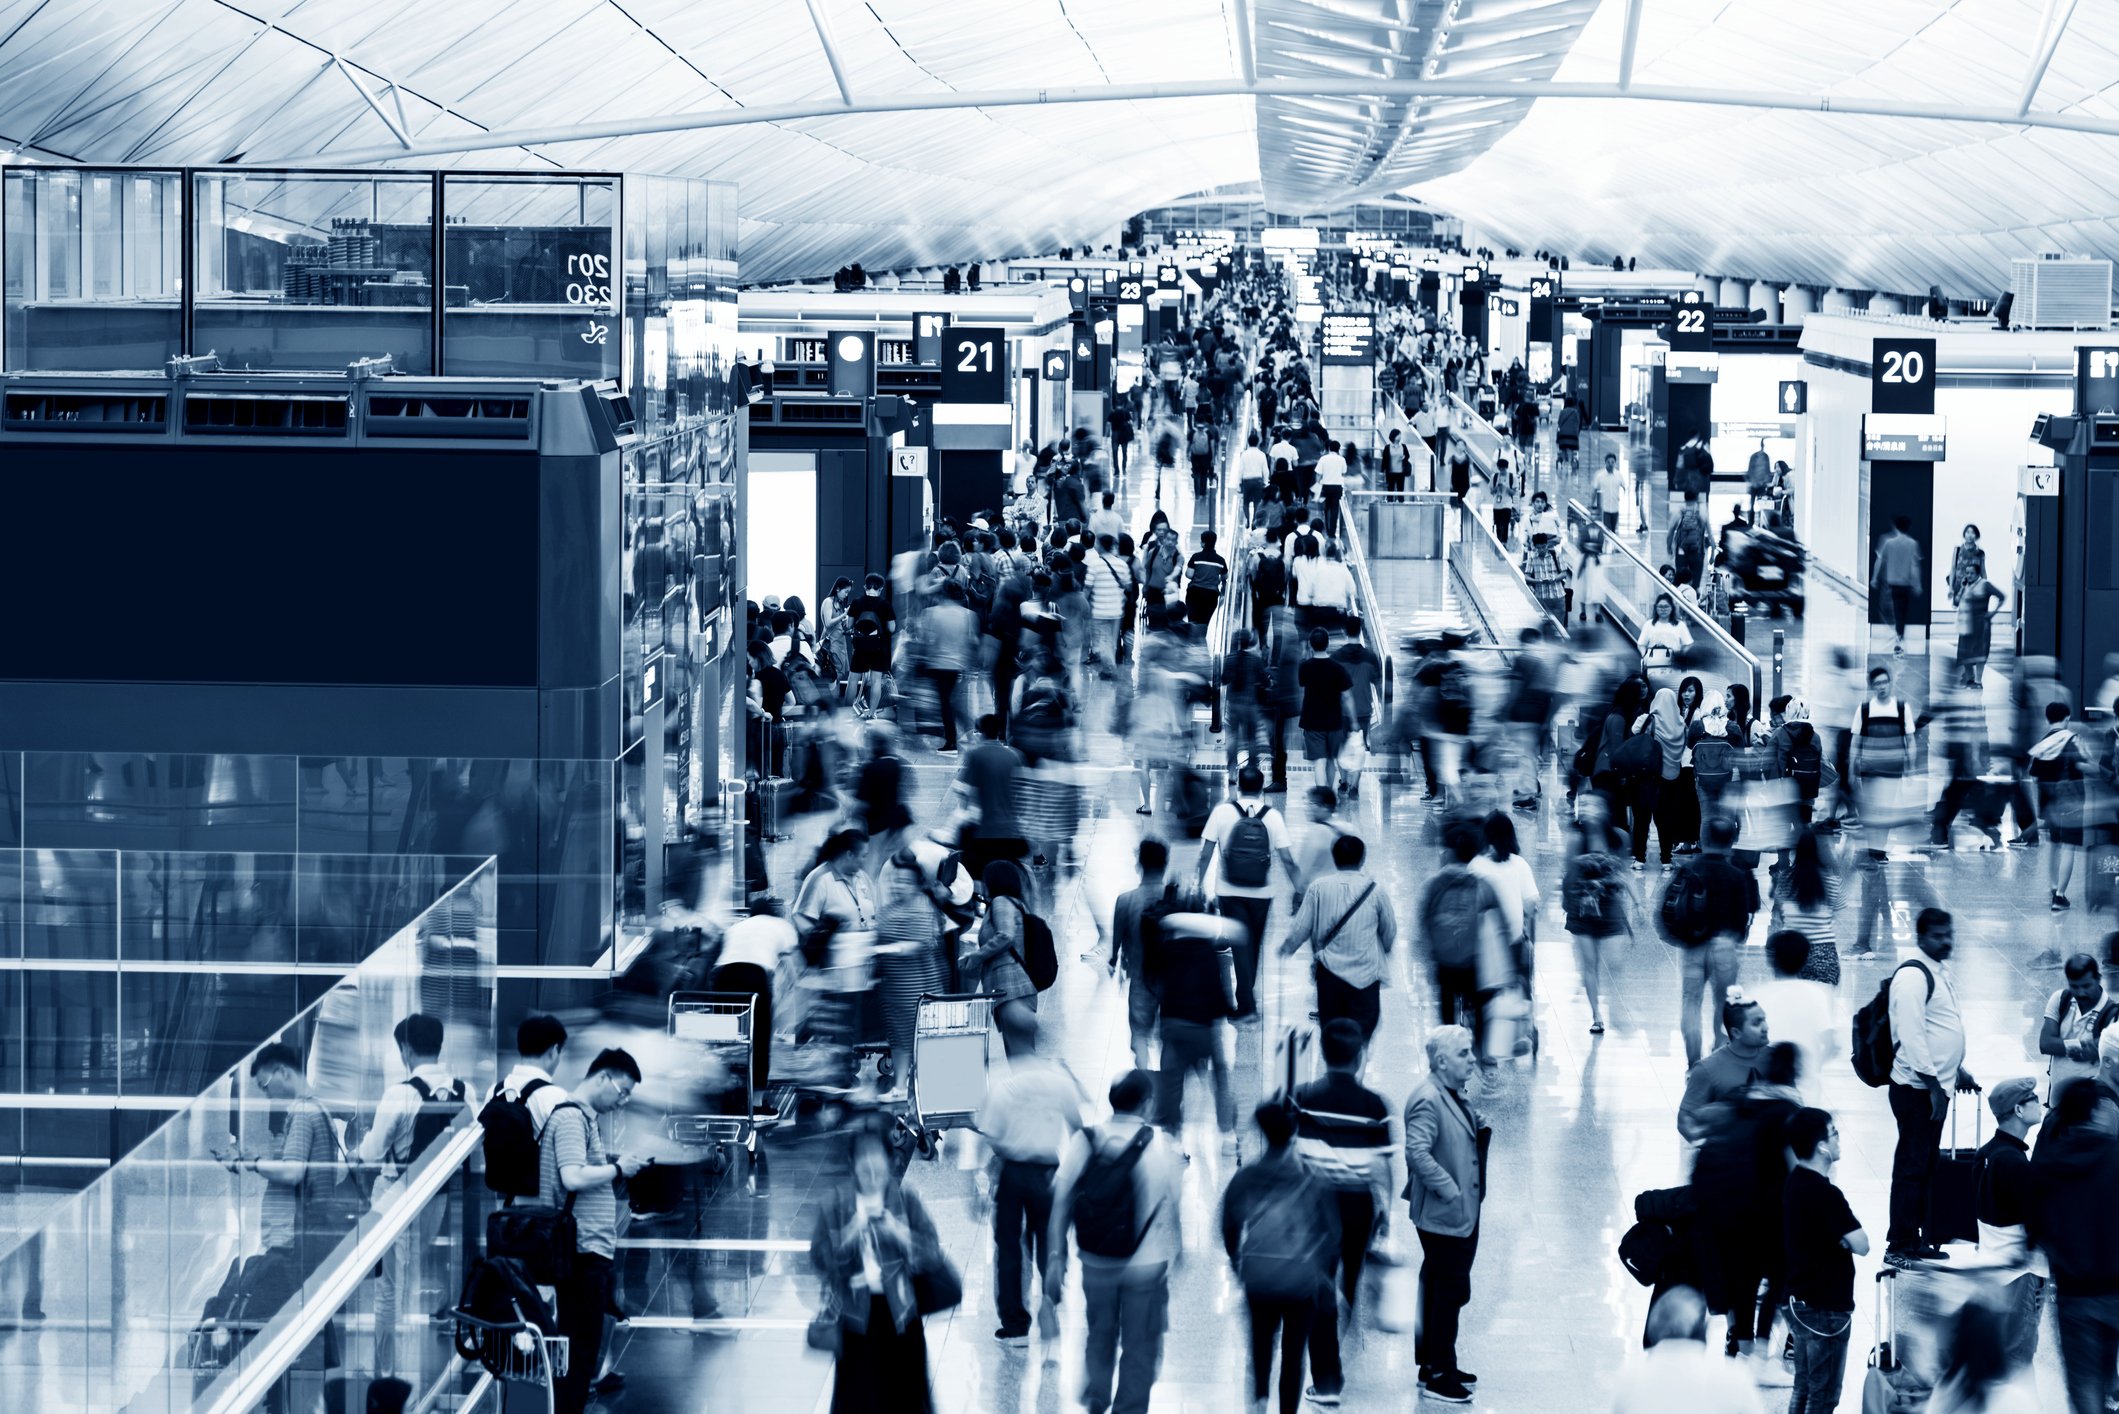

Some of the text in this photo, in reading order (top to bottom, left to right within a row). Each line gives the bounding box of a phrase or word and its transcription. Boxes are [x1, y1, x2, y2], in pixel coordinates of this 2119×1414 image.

[1120, 282, 1141, 300] 23
[1531, 281, 1552, 298] 24
[1677, 309, 1705, 333] 22
[957, 340, 993, 373] 21
[1881, 350, 1924, 384] 20
